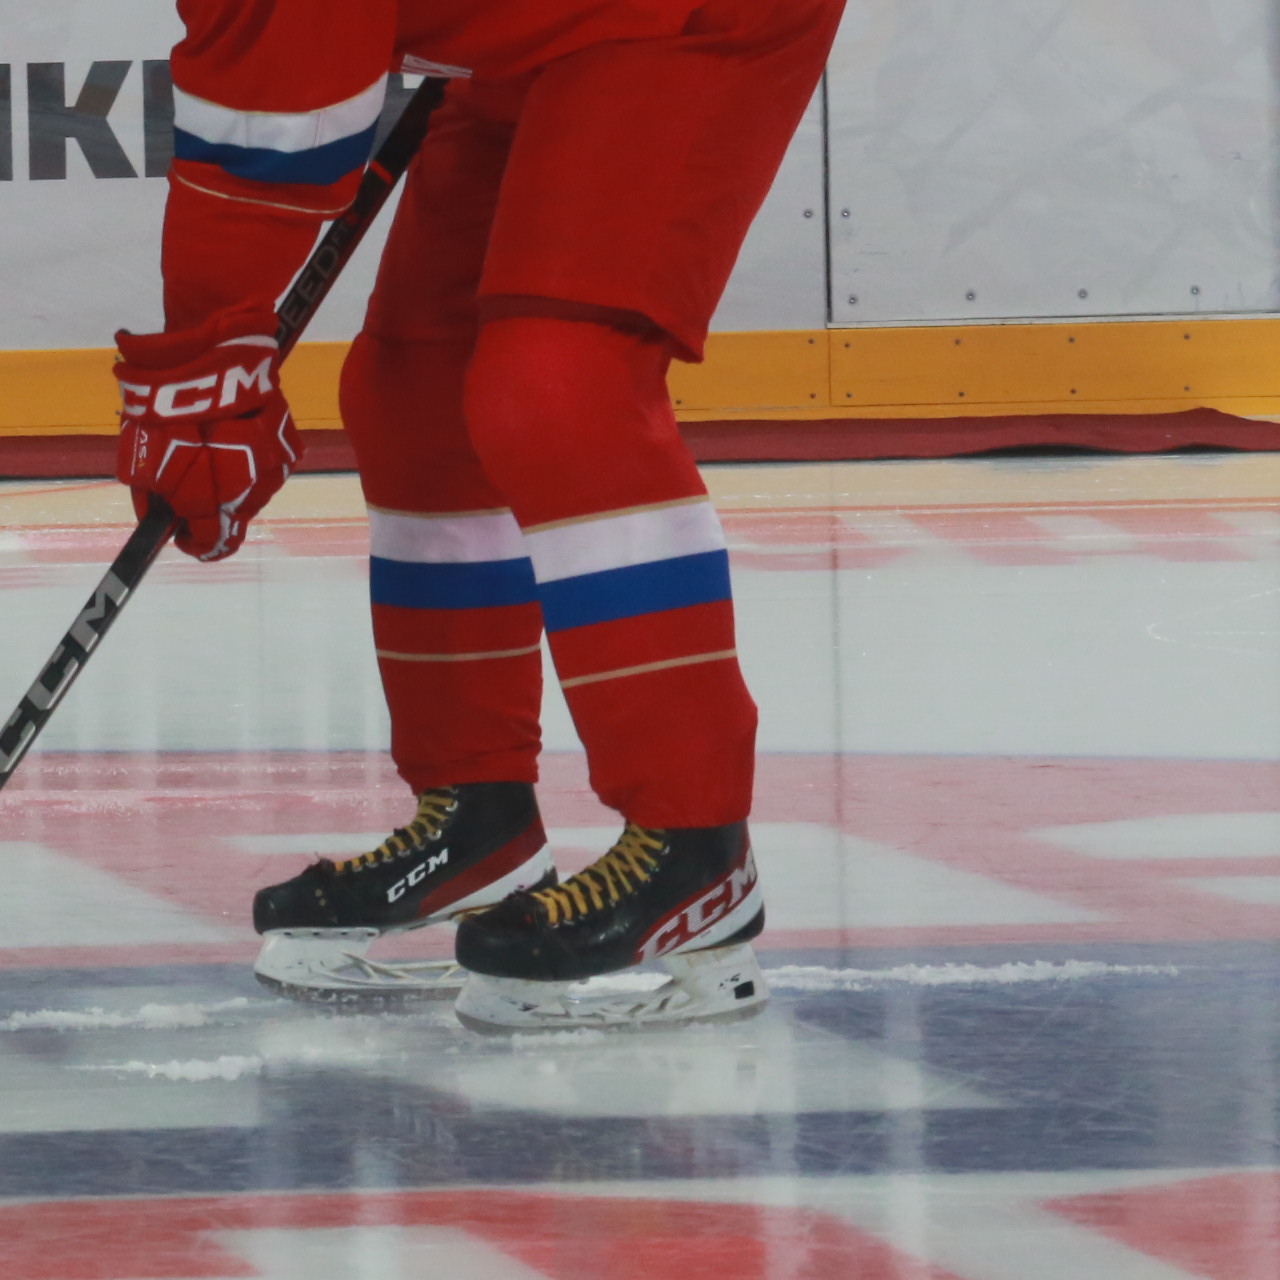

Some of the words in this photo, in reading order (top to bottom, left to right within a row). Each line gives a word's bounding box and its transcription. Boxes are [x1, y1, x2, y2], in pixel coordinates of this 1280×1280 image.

[118, 356, 274, 418] CCM
[386, 847, 449, 904] CCM
[637, 846, 759, 959] CCM
